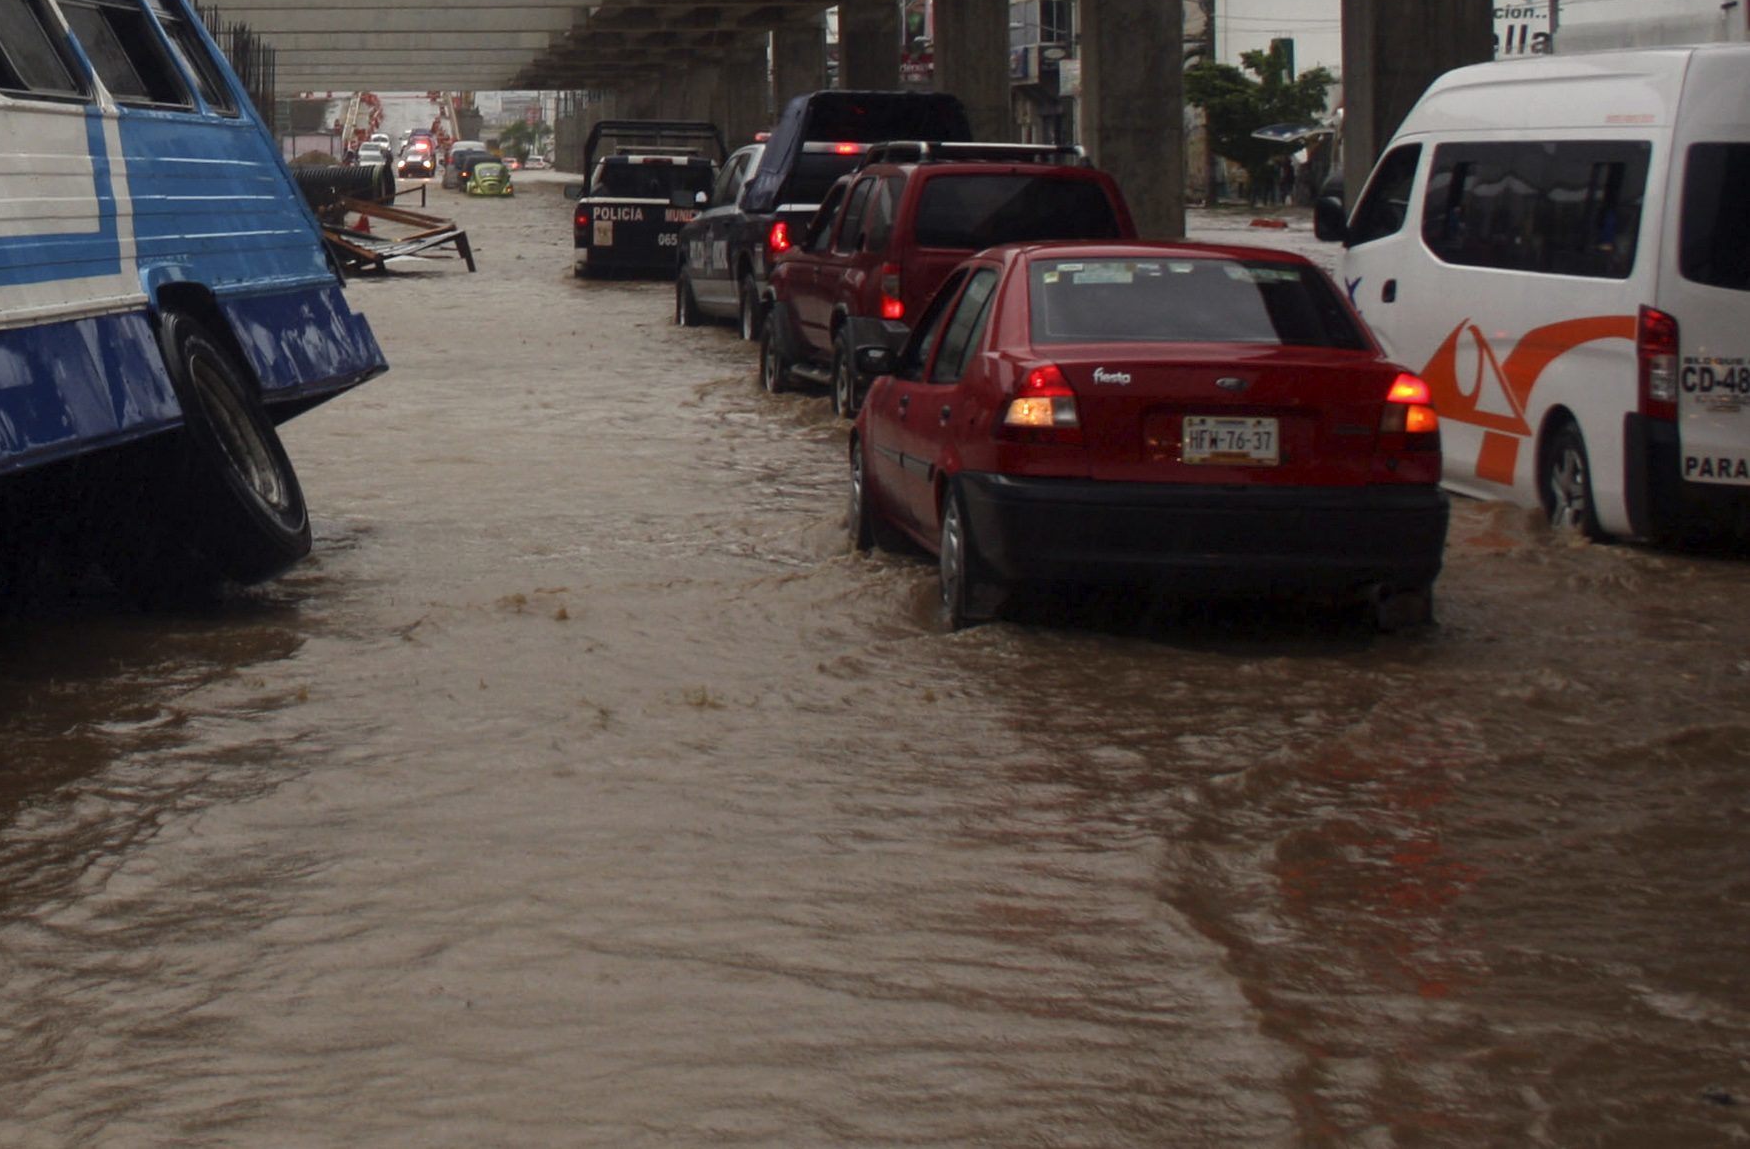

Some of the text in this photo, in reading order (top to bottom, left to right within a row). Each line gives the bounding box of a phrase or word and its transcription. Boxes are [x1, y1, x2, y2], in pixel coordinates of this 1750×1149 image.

[593, 207, 643, 221] POLICÍA
[658, 233, 678, 246] 065
[1685, 457, 1749, 478] PARA
